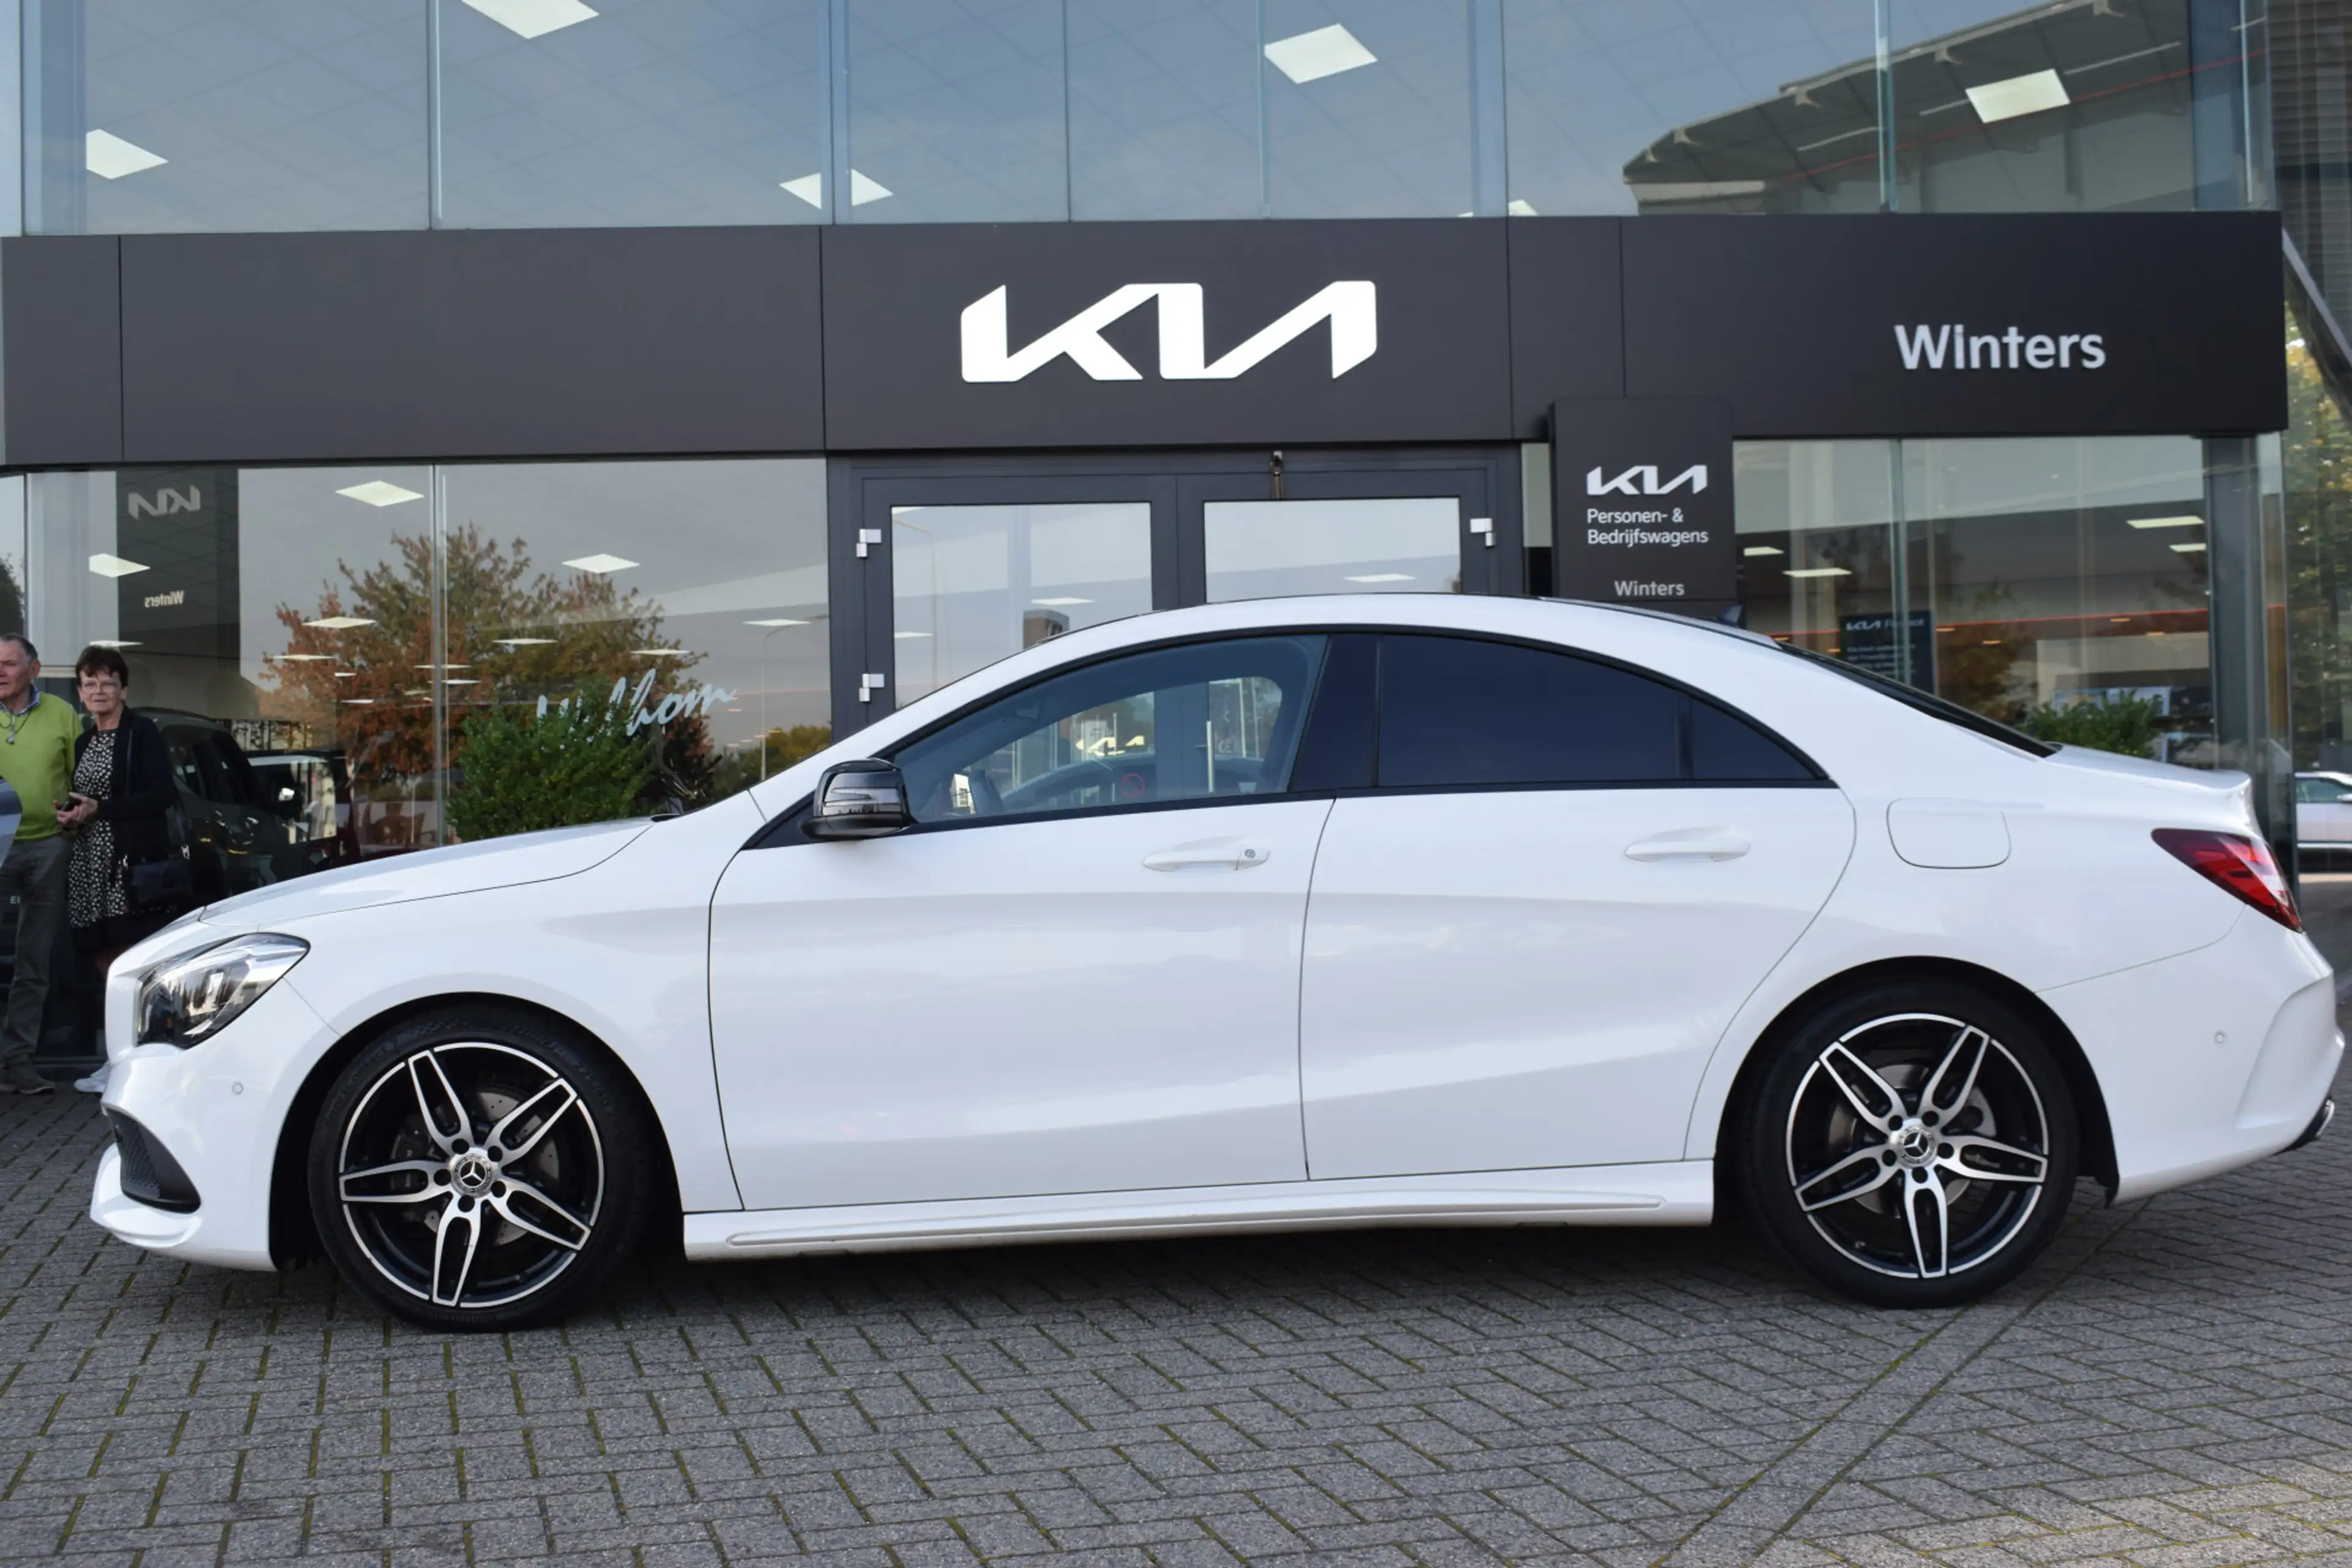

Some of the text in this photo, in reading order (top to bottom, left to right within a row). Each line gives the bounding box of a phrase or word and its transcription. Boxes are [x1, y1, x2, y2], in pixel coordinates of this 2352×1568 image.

[961, 281, 1377, 383] KIA
[1894, 325, 2106, 369] Winters
[1586, 465, 1708, 496] KIA
[1587, 508, 1684, 524] Personen- &
[1588, 529, 1709, 548] Bedrijfswagens
[1615, 581, 1685, 596] Winters
